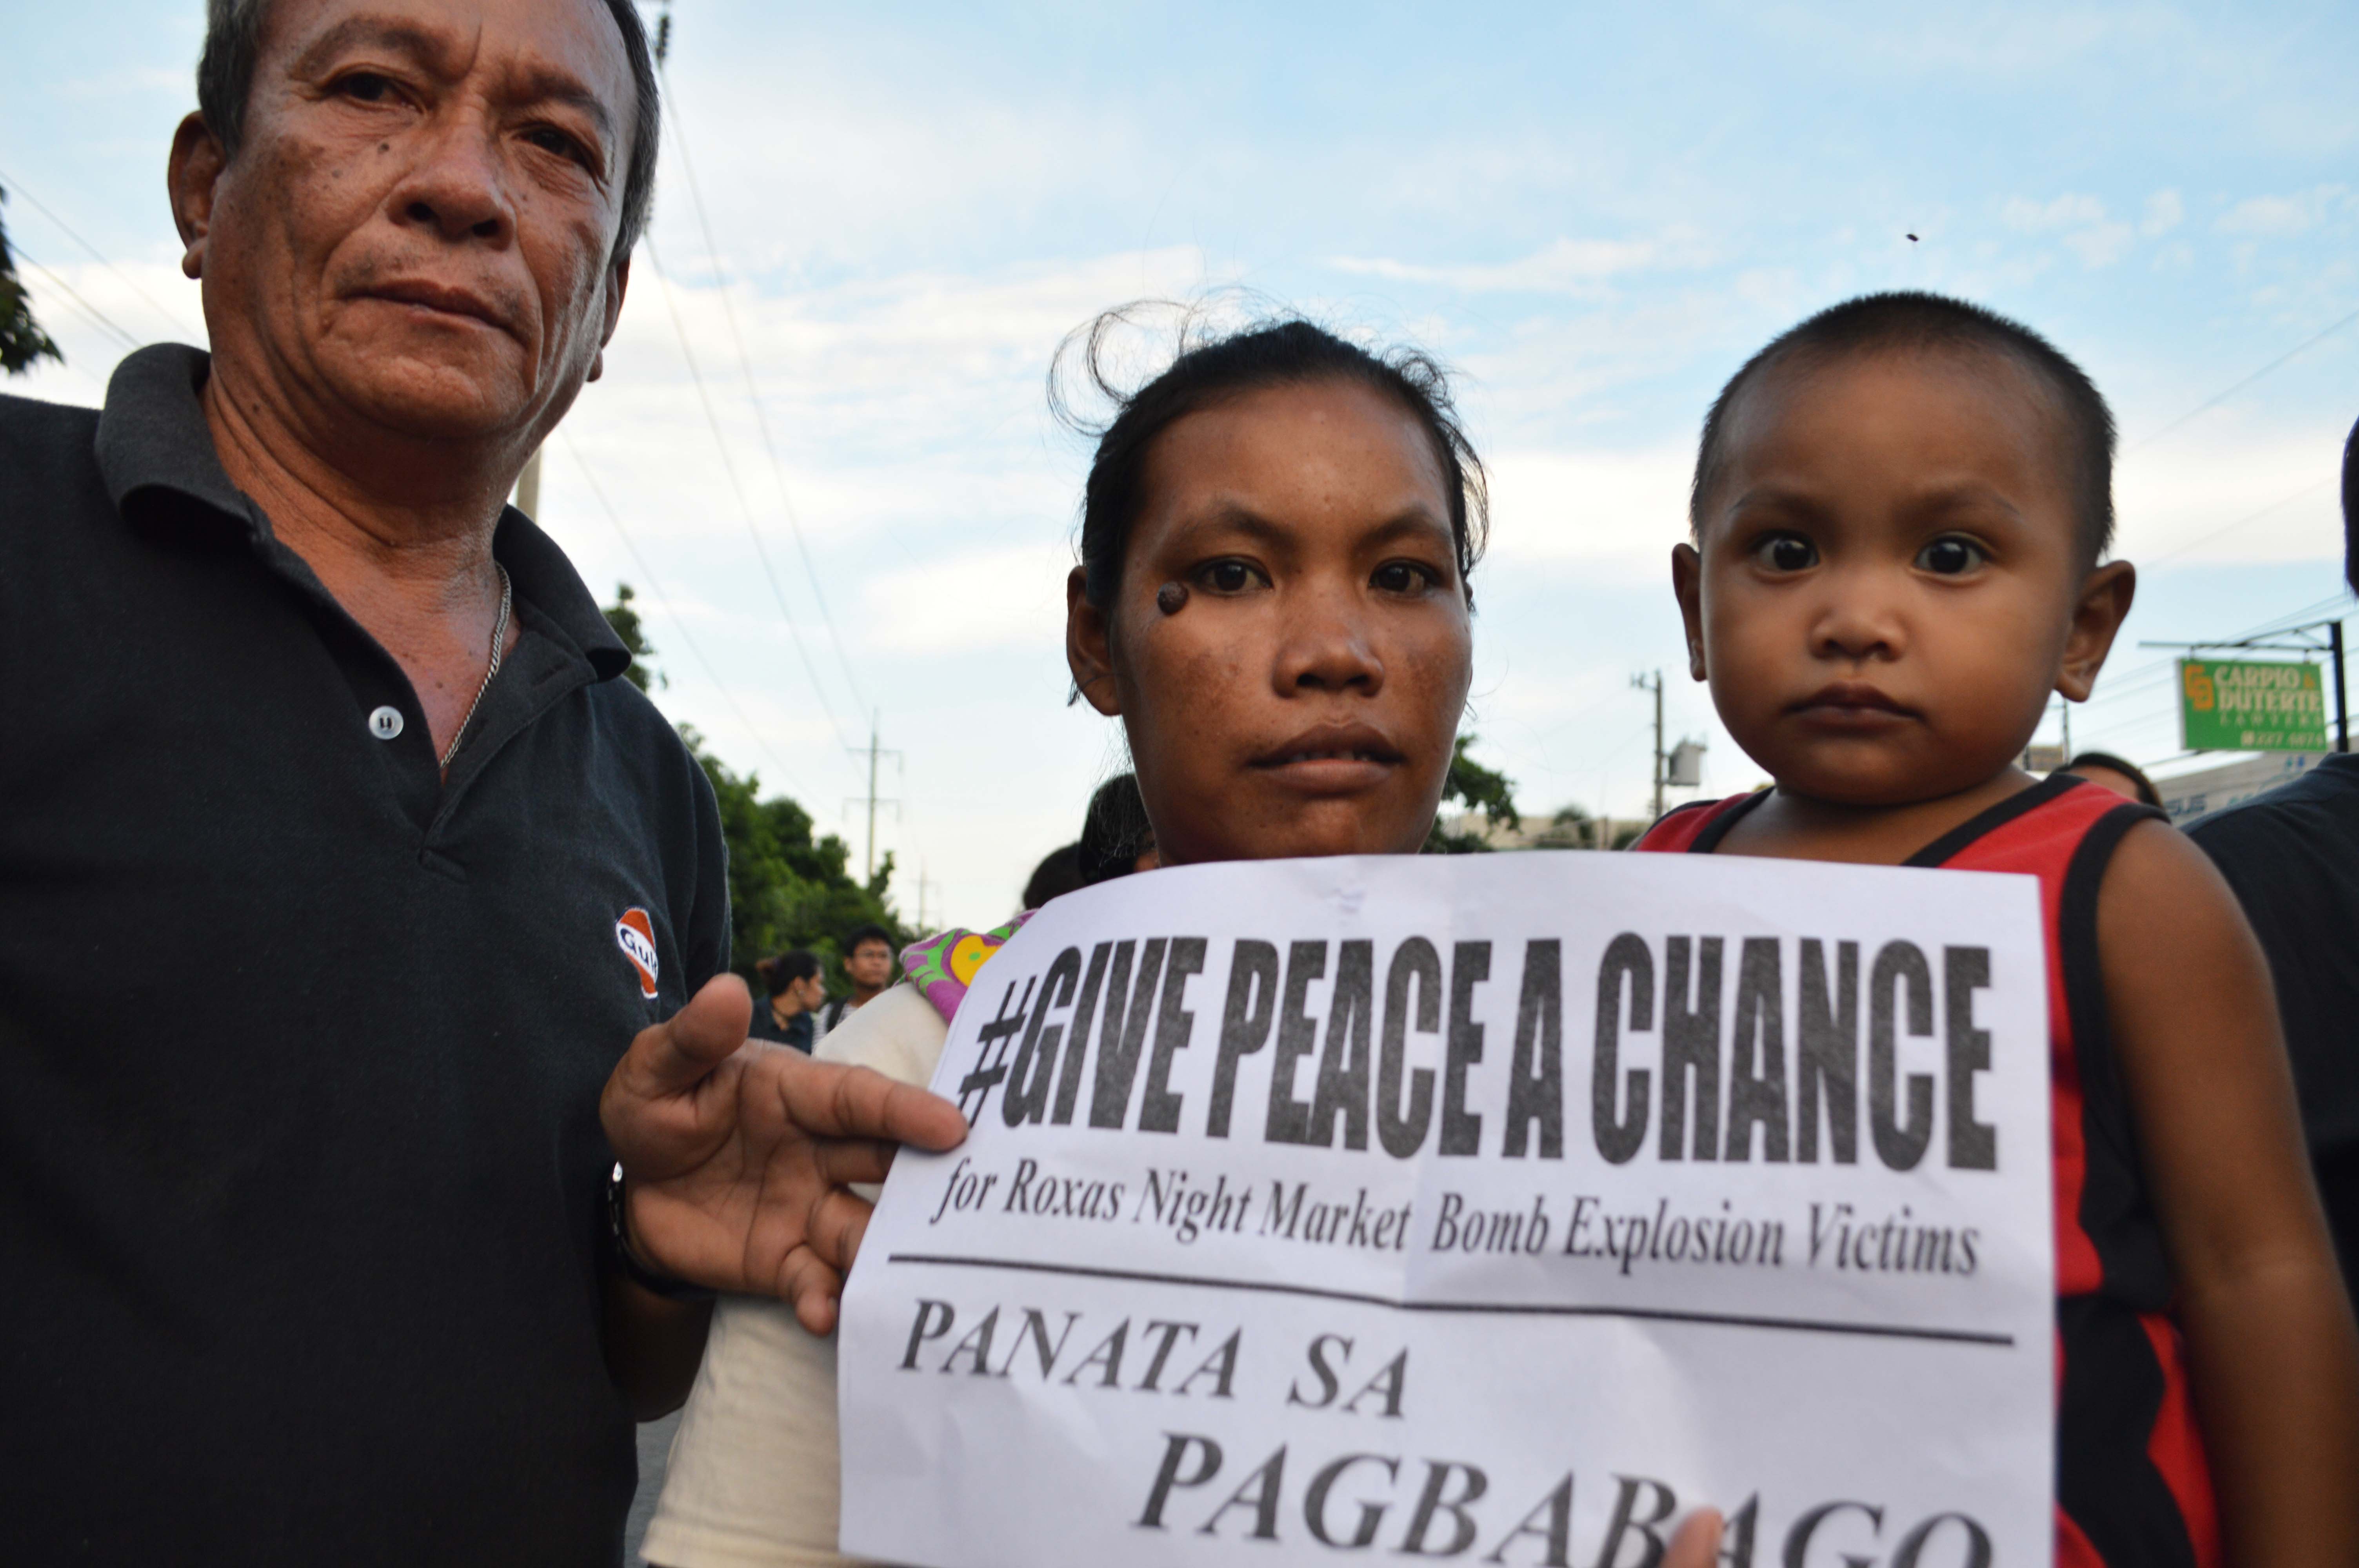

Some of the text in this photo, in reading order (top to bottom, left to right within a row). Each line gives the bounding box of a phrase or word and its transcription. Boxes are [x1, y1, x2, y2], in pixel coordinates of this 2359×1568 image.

[2214, 665, 2300, 689] CARPIO
[2217, 689, 2322, 712] DUTERTE
[957, 931, 1998, 1173] #GIVE PEACE A CHANCE
[929, 1156, 1979, 1276] for Roxas Night Market Bomb Explosion Victims
[896, 1298, 1409, 1419] PANATA SA
[1129, 1430, 1994, 1568] PAGBABAGO
